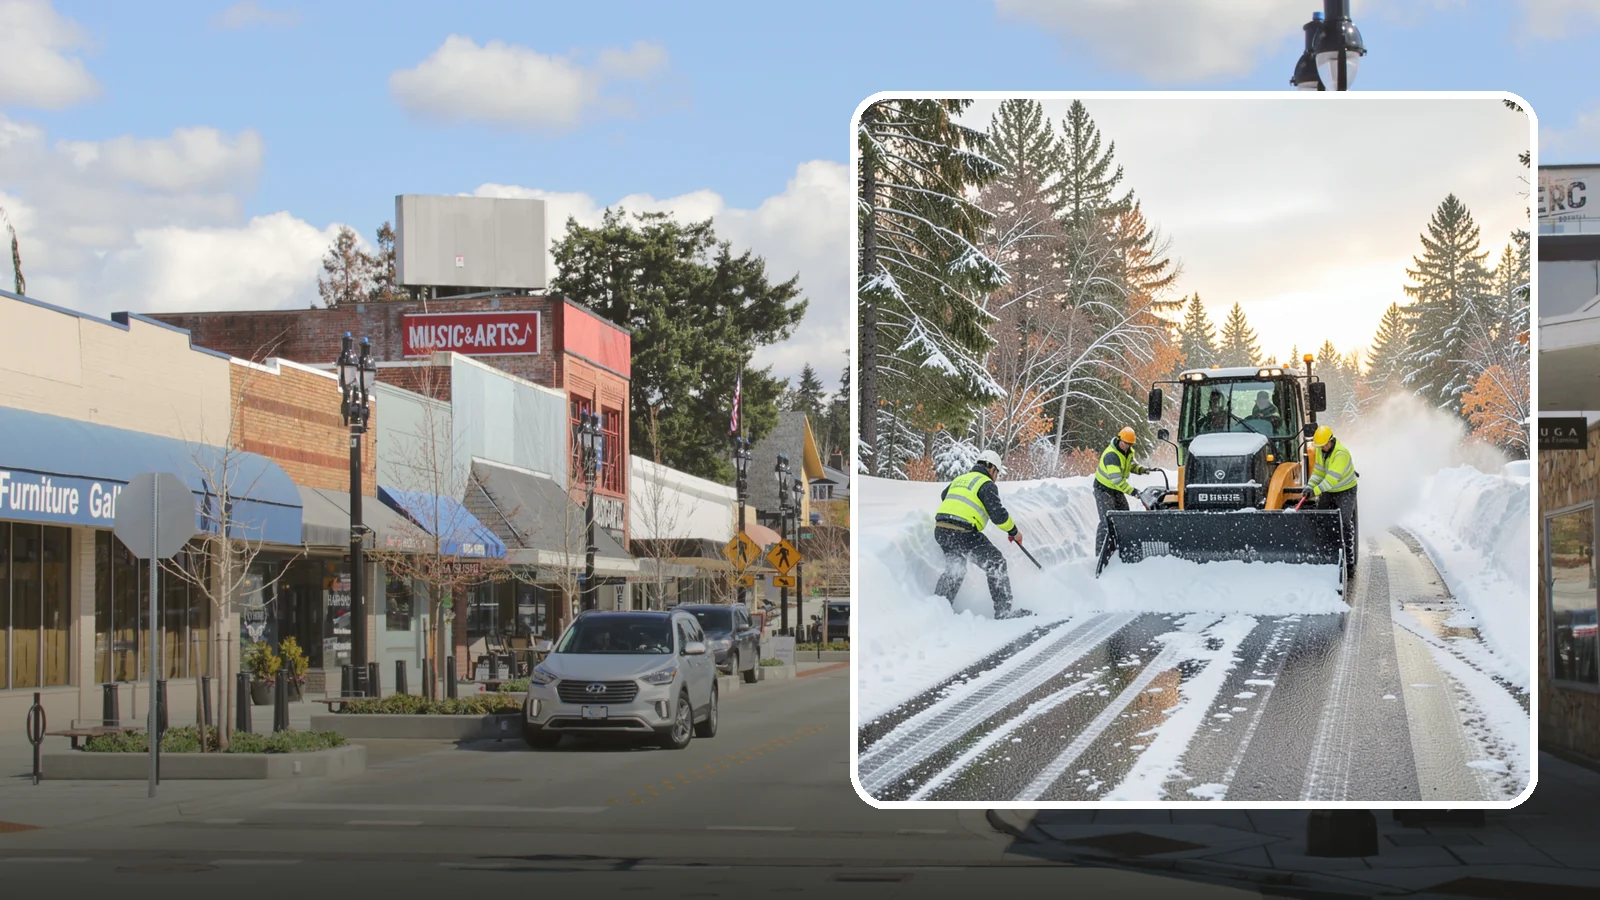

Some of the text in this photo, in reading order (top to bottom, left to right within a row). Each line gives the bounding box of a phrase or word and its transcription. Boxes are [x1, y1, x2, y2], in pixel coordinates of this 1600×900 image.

[0, 470, 122, 519] Furniture Gal
[453, 563, 479, 574] SUSHI
